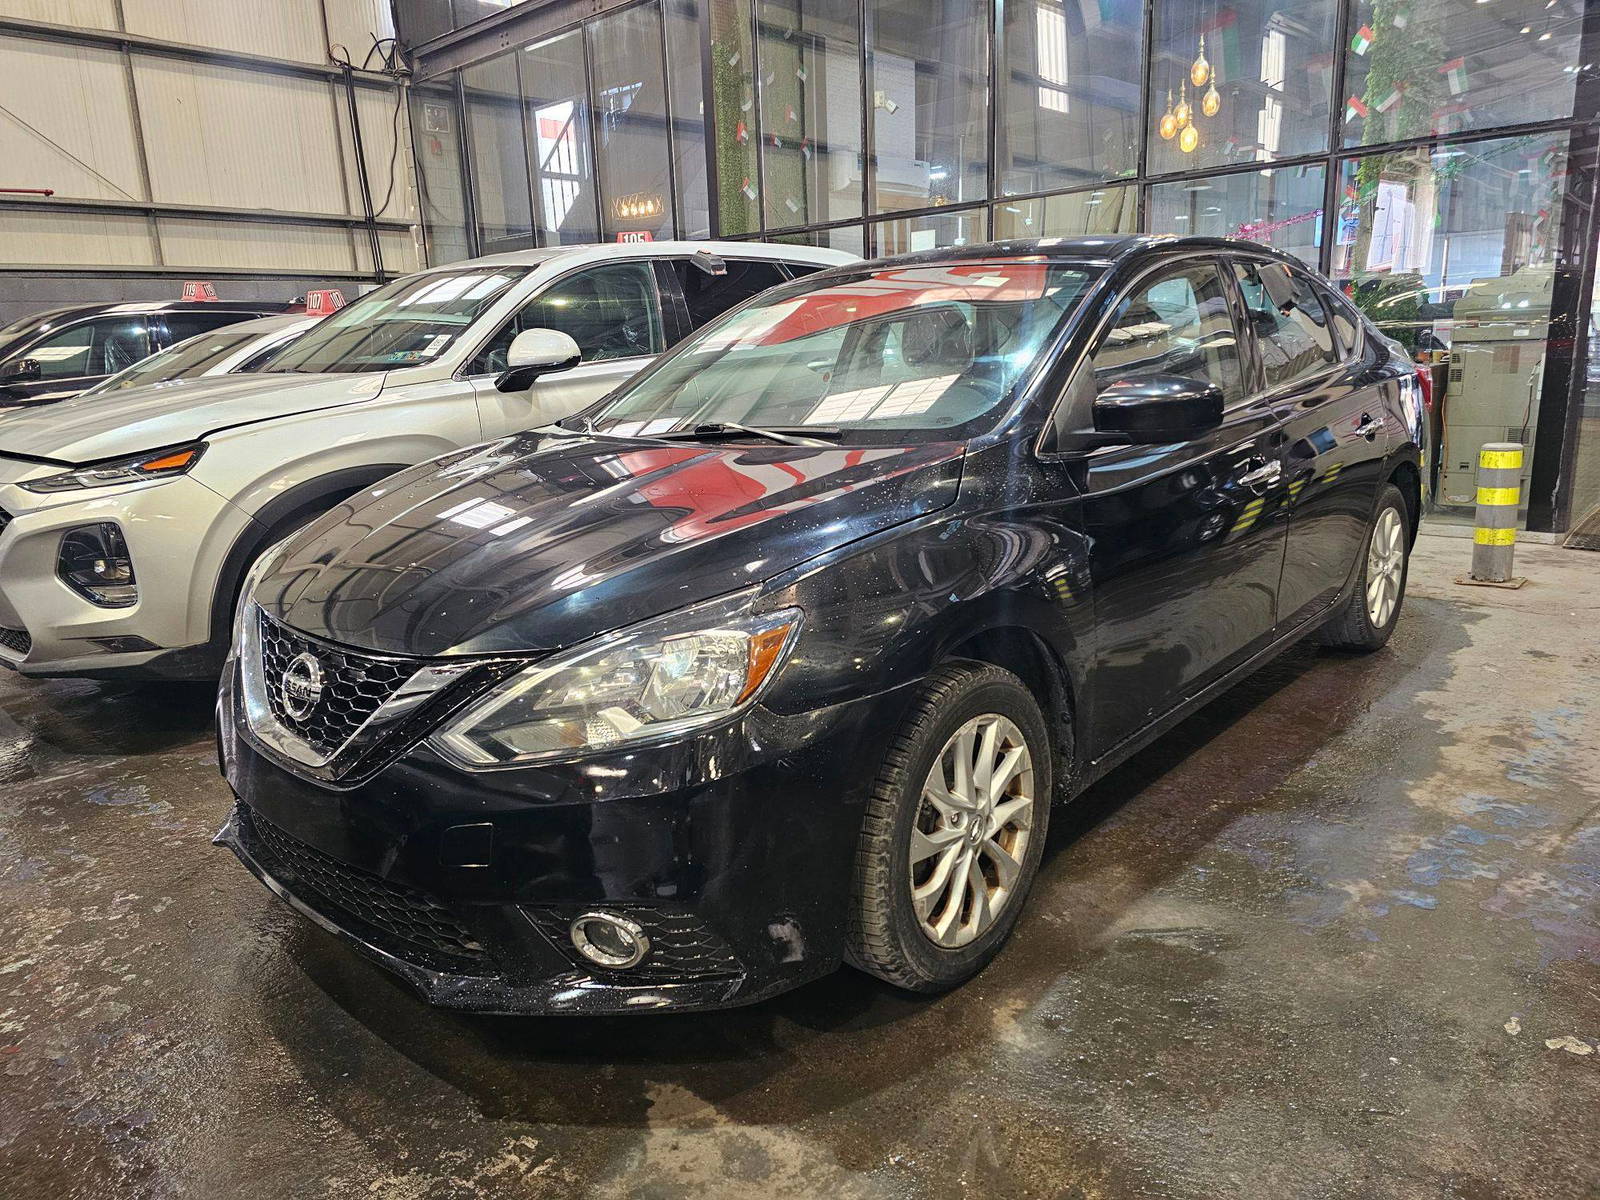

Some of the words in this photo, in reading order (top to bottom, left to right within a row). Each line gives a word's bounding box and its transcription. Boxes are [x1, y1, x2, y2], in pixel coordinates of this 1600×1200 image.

[623, 233, 645, 243] 105
[186, 283, 196, 296] 119
[310, 292, 321, 309] 107
